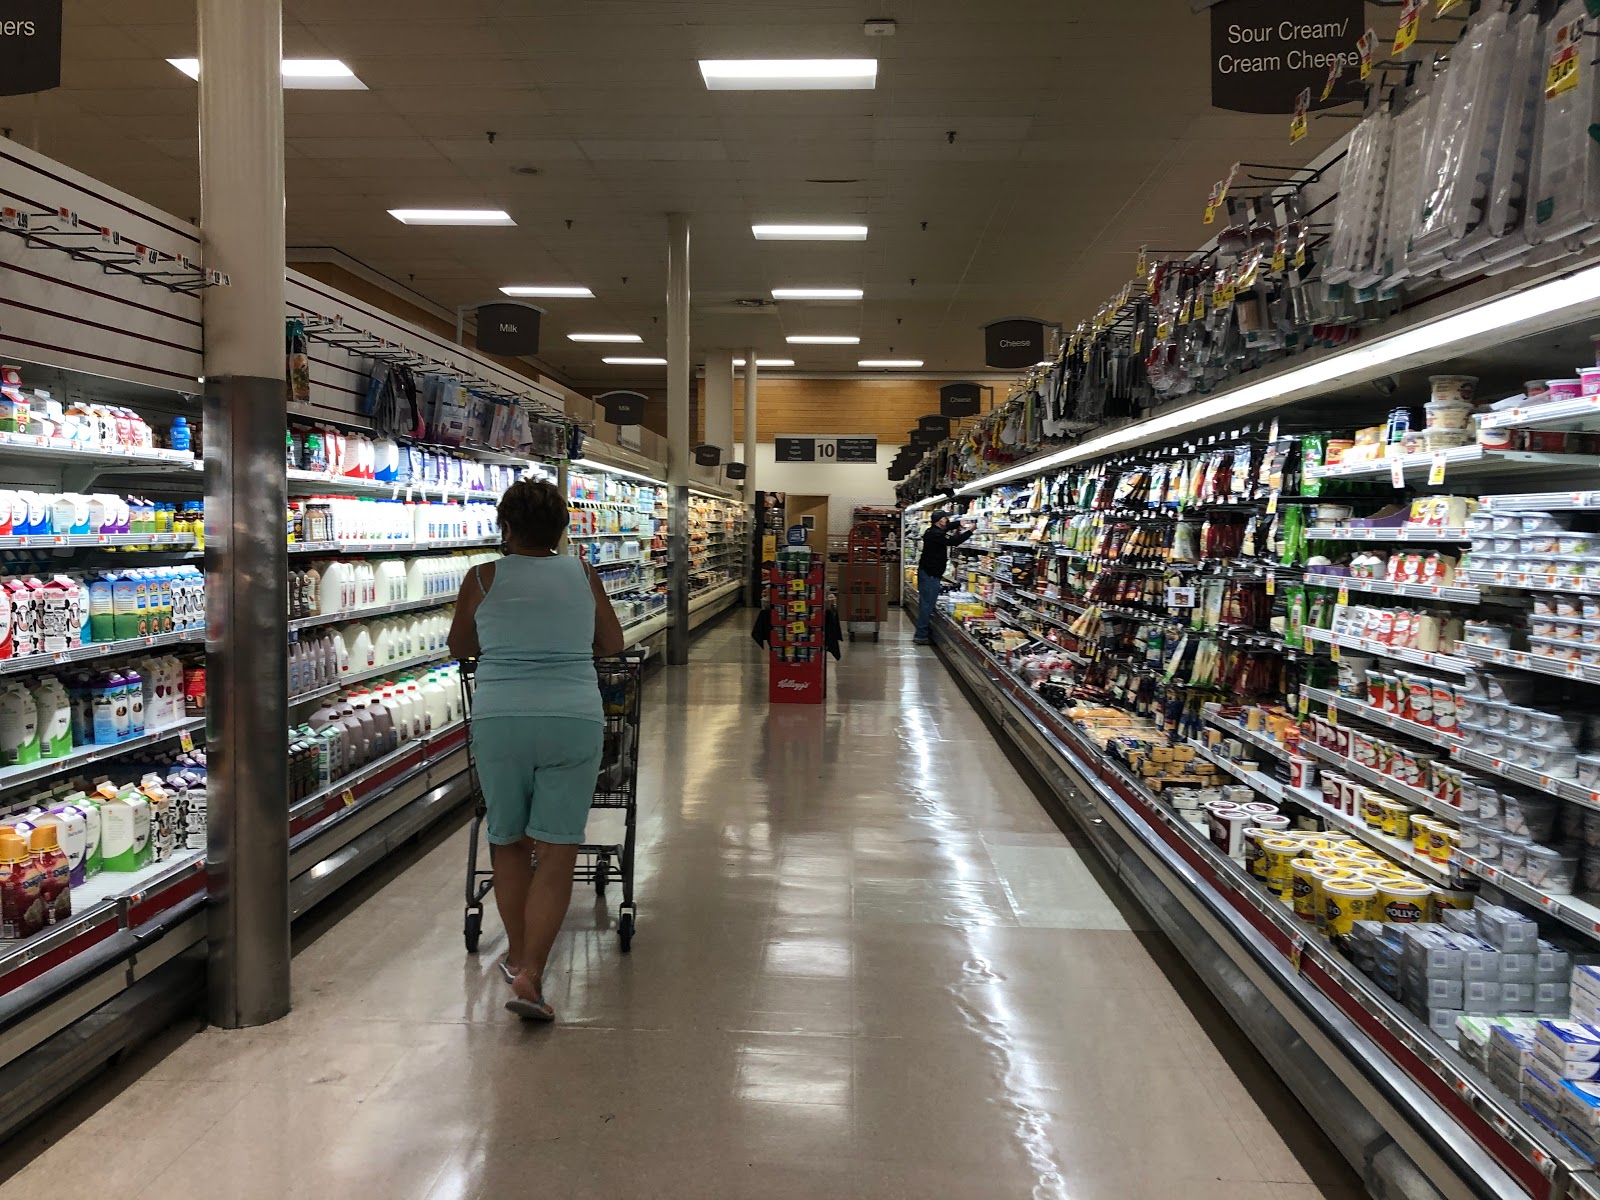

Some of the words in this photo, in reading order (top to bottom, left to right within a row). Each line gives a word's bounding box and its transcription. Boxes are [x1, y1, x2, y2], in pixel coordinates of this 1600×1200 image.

[0, 20, 35, 36] ers
[1228, 24, 1273, 44] Sour
[1278, 17, 1350, 41] Cream/
[1218, 54, 1281, 74] Cream
[1287, 49, 1359, 70] Cheese
[499, 323, 518, 333] Milk
[999, 339, 1031, 348] Cheese
[817, 443, 835, 458] 10
[777, 679, 811, 691] Kellogg's
[1386, 907, 1421, 919] POLLY-O
